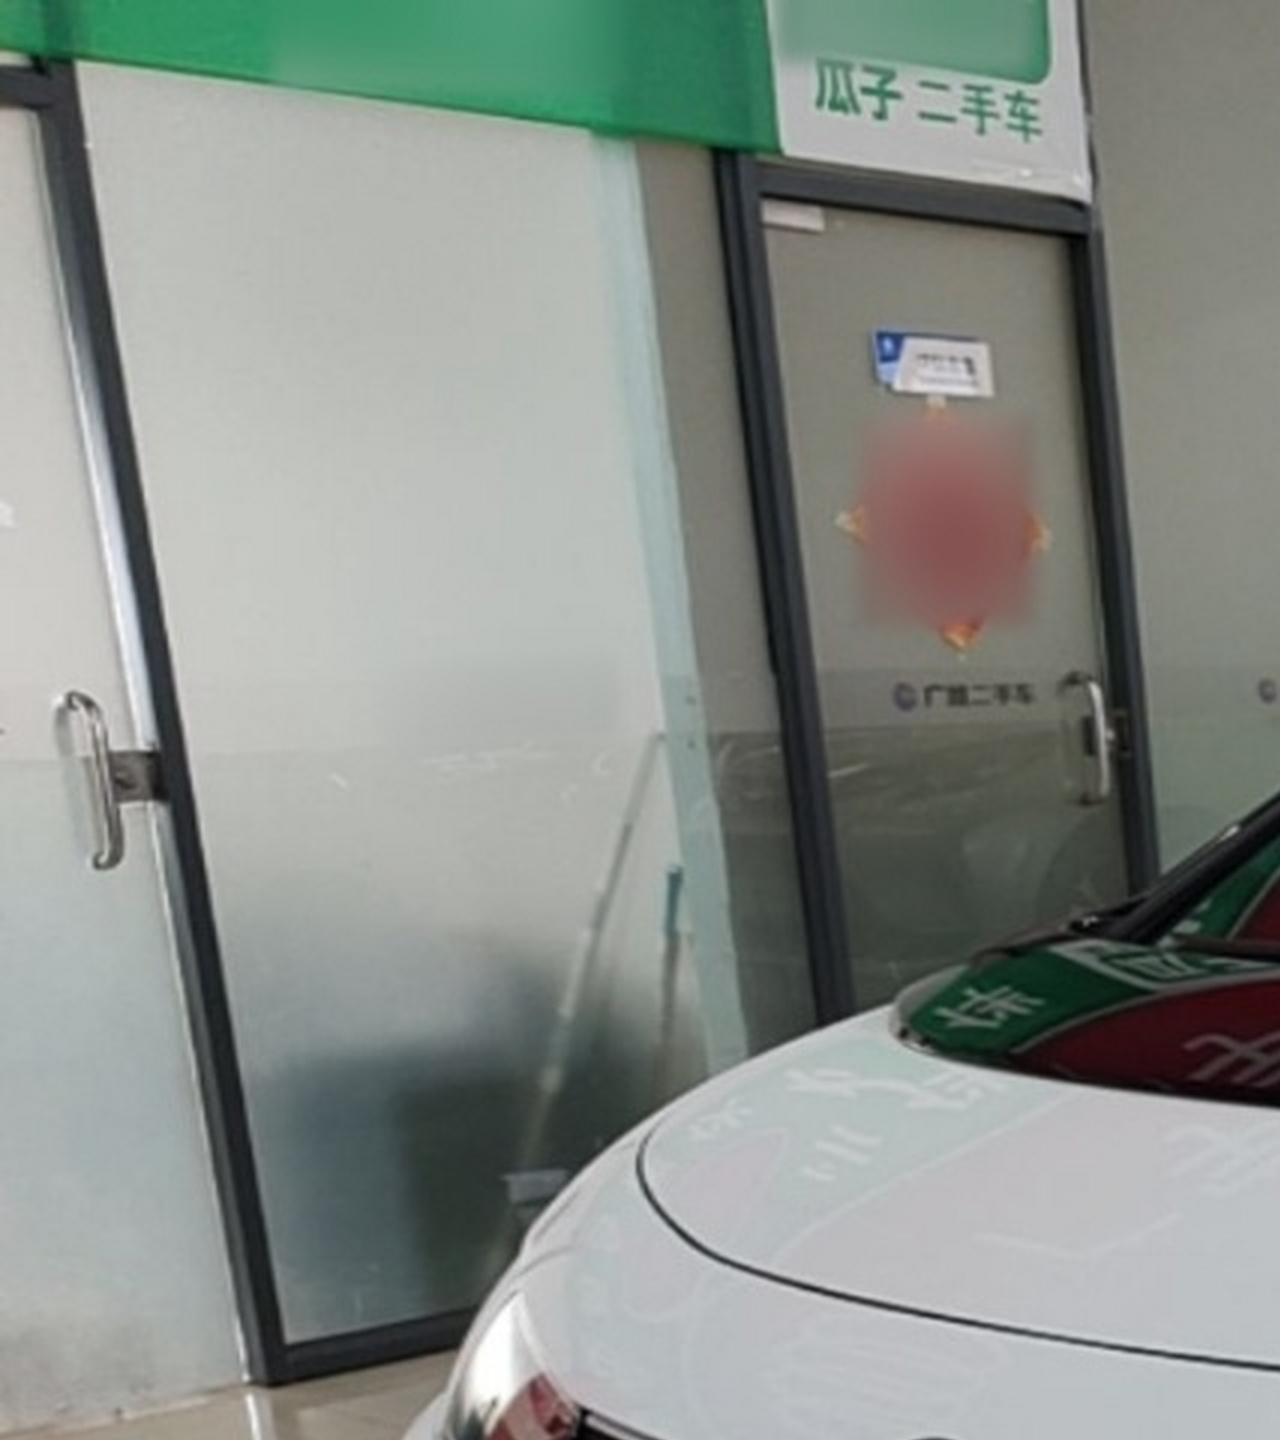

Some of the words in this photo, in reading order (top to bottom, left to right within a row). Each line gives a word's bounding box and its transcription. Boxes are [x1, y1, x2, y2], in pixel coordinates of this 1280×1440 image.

[815, 58, 1044, 143] 瓜子二手车
